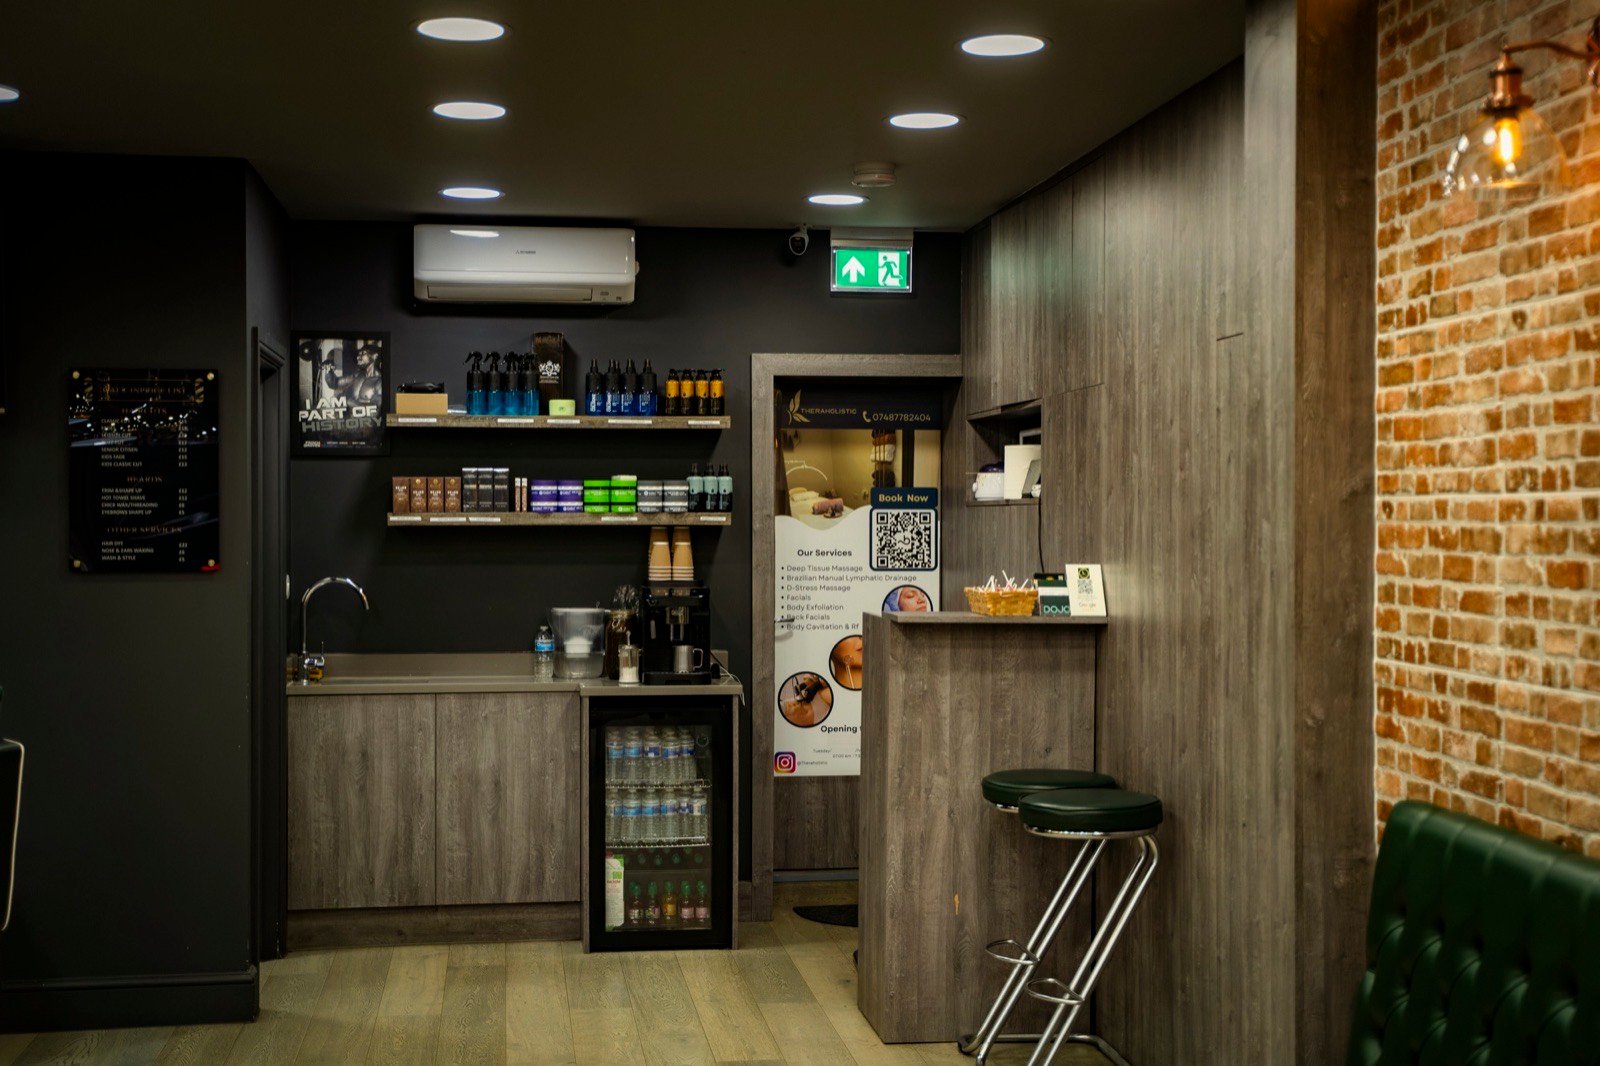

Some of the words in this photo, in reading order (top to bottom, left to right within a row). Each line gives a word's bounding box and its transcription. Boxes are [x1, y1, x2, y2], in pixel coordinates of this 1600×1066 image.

[305, 398, 311, 410] I
[316, 396, 347, 410] AM
[298, 408, 347, 422] PART
[352, 405, 377, 418] OF
[800, 407, 857, 415] THERAHOLISTIC
[872, 413, 931, 421] 07487782404
[301, 416, 382, 433] HISTORY
[127, 475, 163, 483] BEARDS
[878, 493, 903, 503] Book
[906, 494, 929, 503] Now
[797, 549, 813, 557] Our
[815, 548, 852, 557] Services
[786, 565, 806, 573] Deep
[831, 565, 863, 573] Massage
[846, 574, 883, 582] Lymphatic
[884, 574, 917, 582] Drainage
[819, 585, 851, 593] Massage
[786, 604, 804, 612] Body
[1043, 605, 1070, 614] DOJO
[786, 624, 804, 632] Body
[820, 724, 858, 734] Opening
